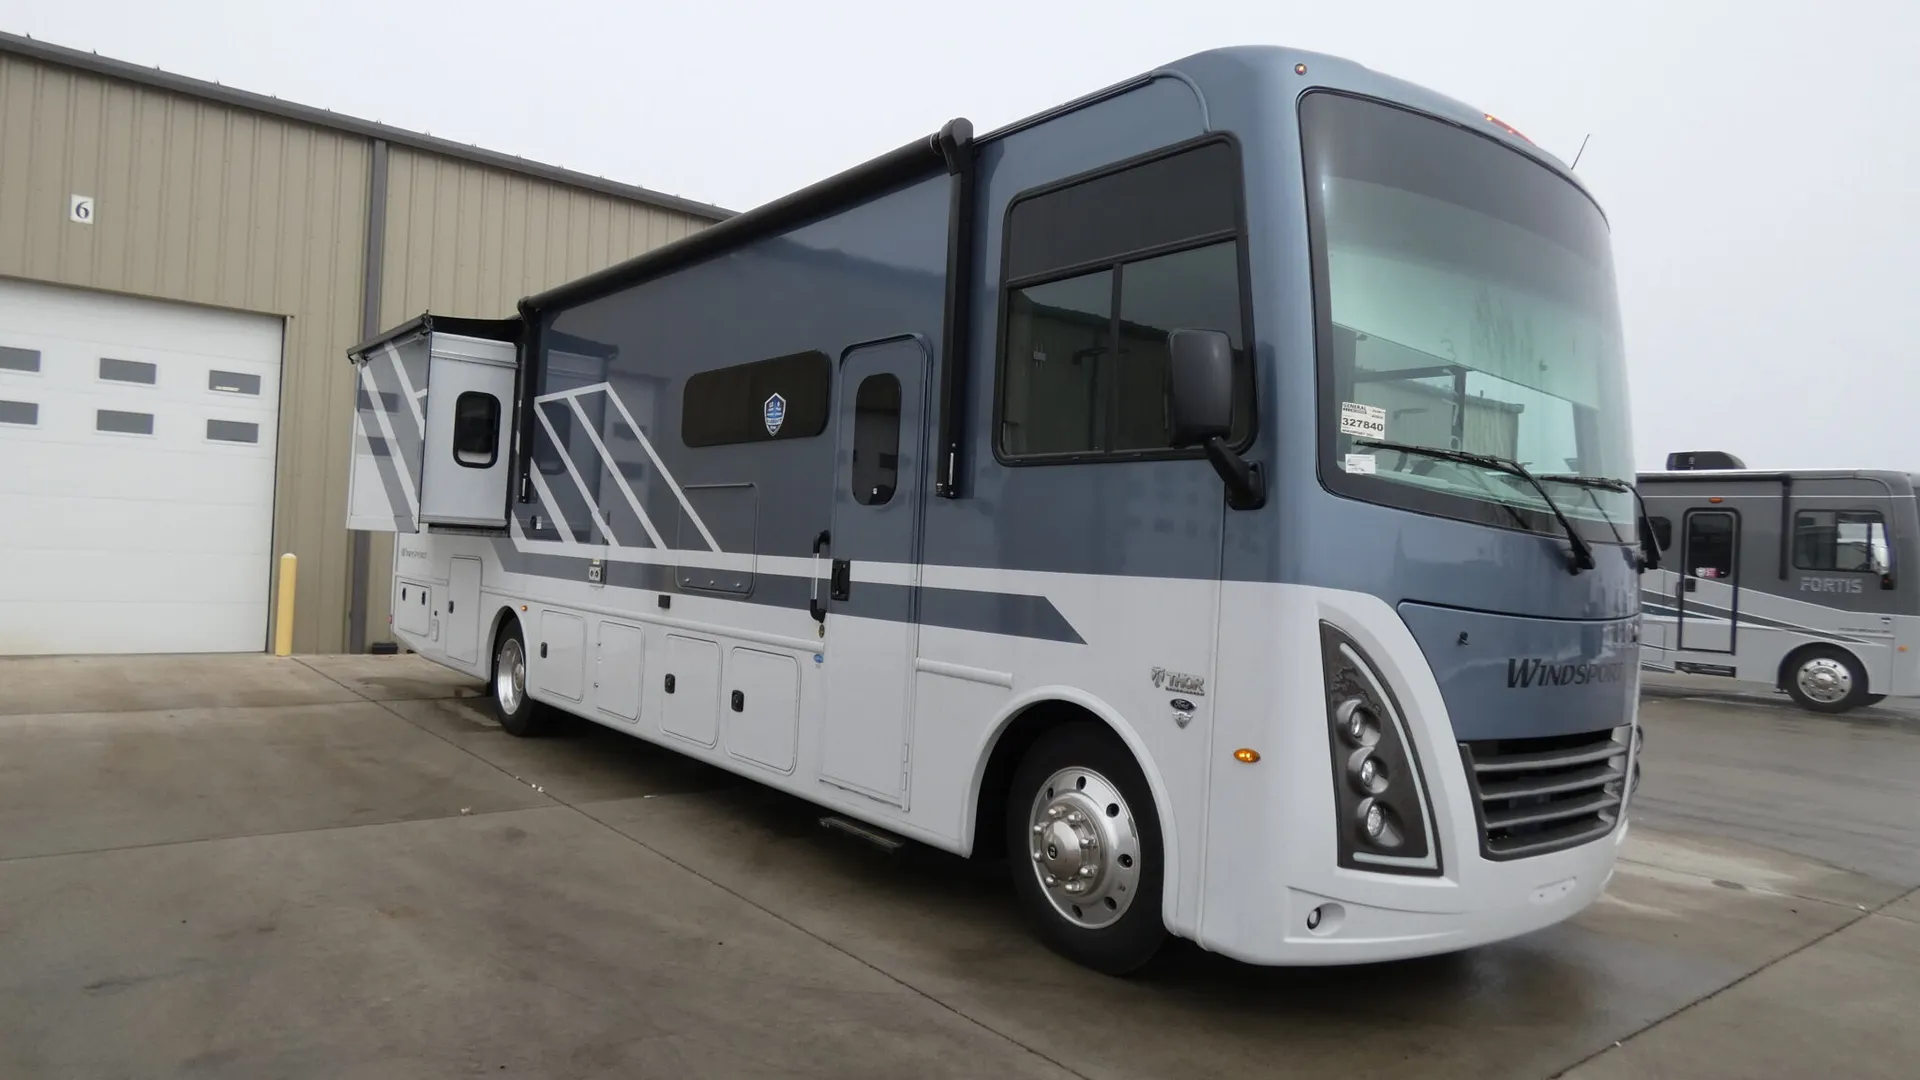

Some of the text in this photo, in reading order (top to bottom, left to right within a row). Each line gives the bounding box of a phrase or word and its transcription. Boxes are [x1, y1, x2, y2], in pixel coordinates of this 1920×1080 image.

[75, 200, 90, 219] 6
[1342, 417, 1384, 432] 327840
[1800, 576, 1863, 594] FORTIS
[1165, 671, 1205, 692] THOR
[1507, 658, 1623, 688] WINDSPORT
